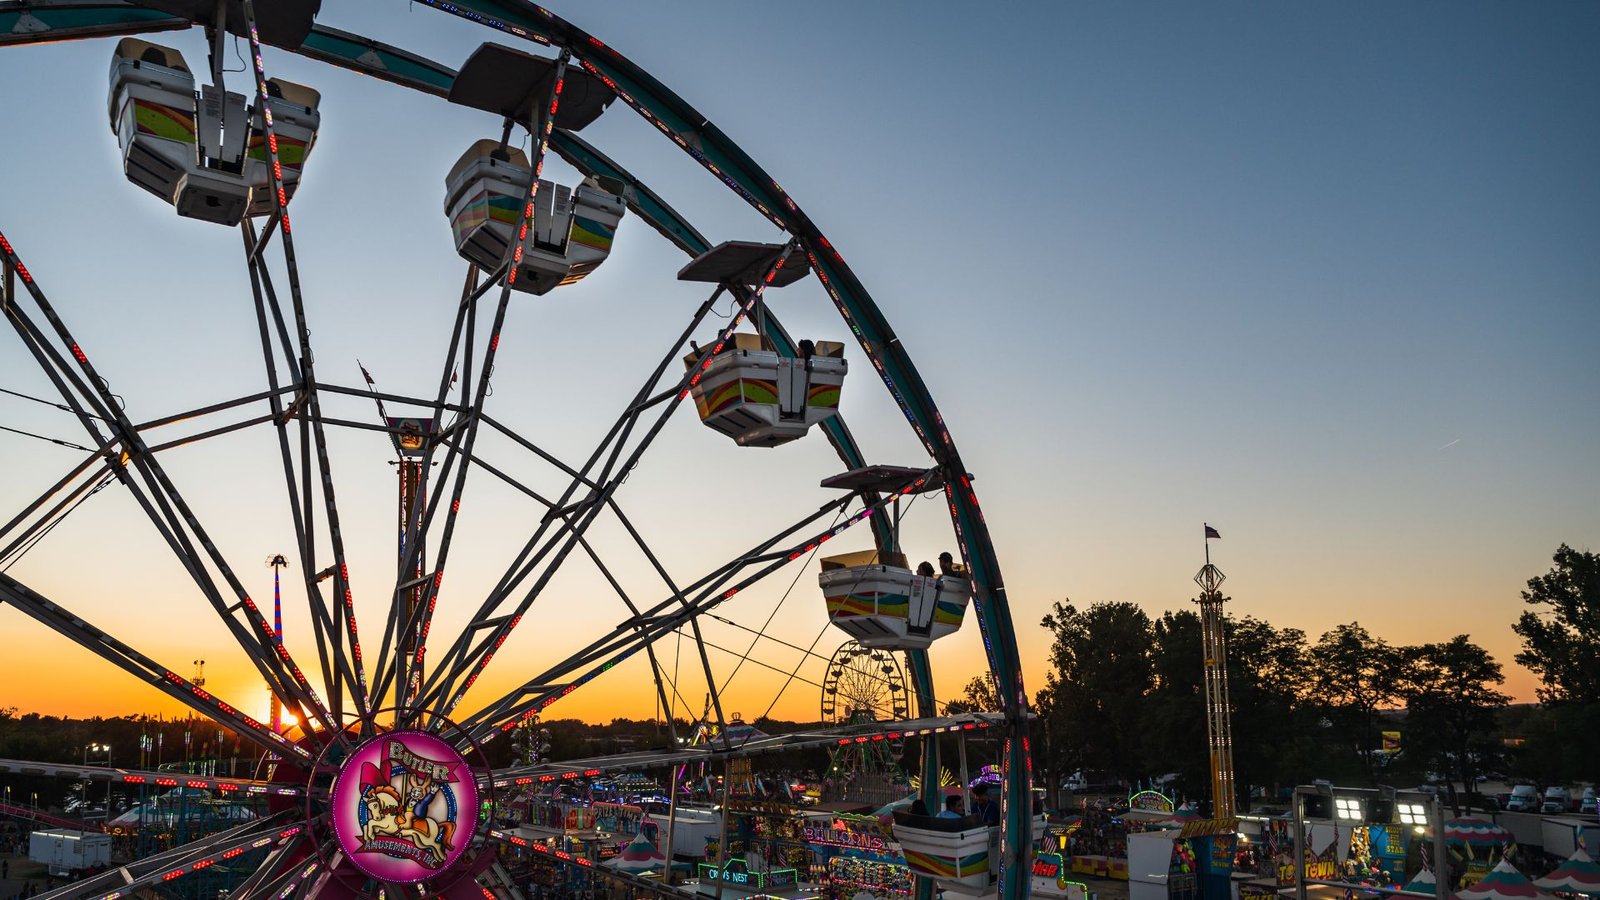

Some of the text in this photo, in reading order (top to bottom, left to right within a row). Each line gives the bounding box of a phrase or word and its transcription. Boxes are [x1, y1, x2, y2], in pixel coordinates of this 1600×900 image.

[390, 742, 449, 780] BUTLER
[806, 828, 883, 849] BALLOONS
[364, 839, 421, 861] AMUSEMENTS,
[732, 872, 748, 883] NEST
[1279, 862, 1335, 880] TO TOWN
